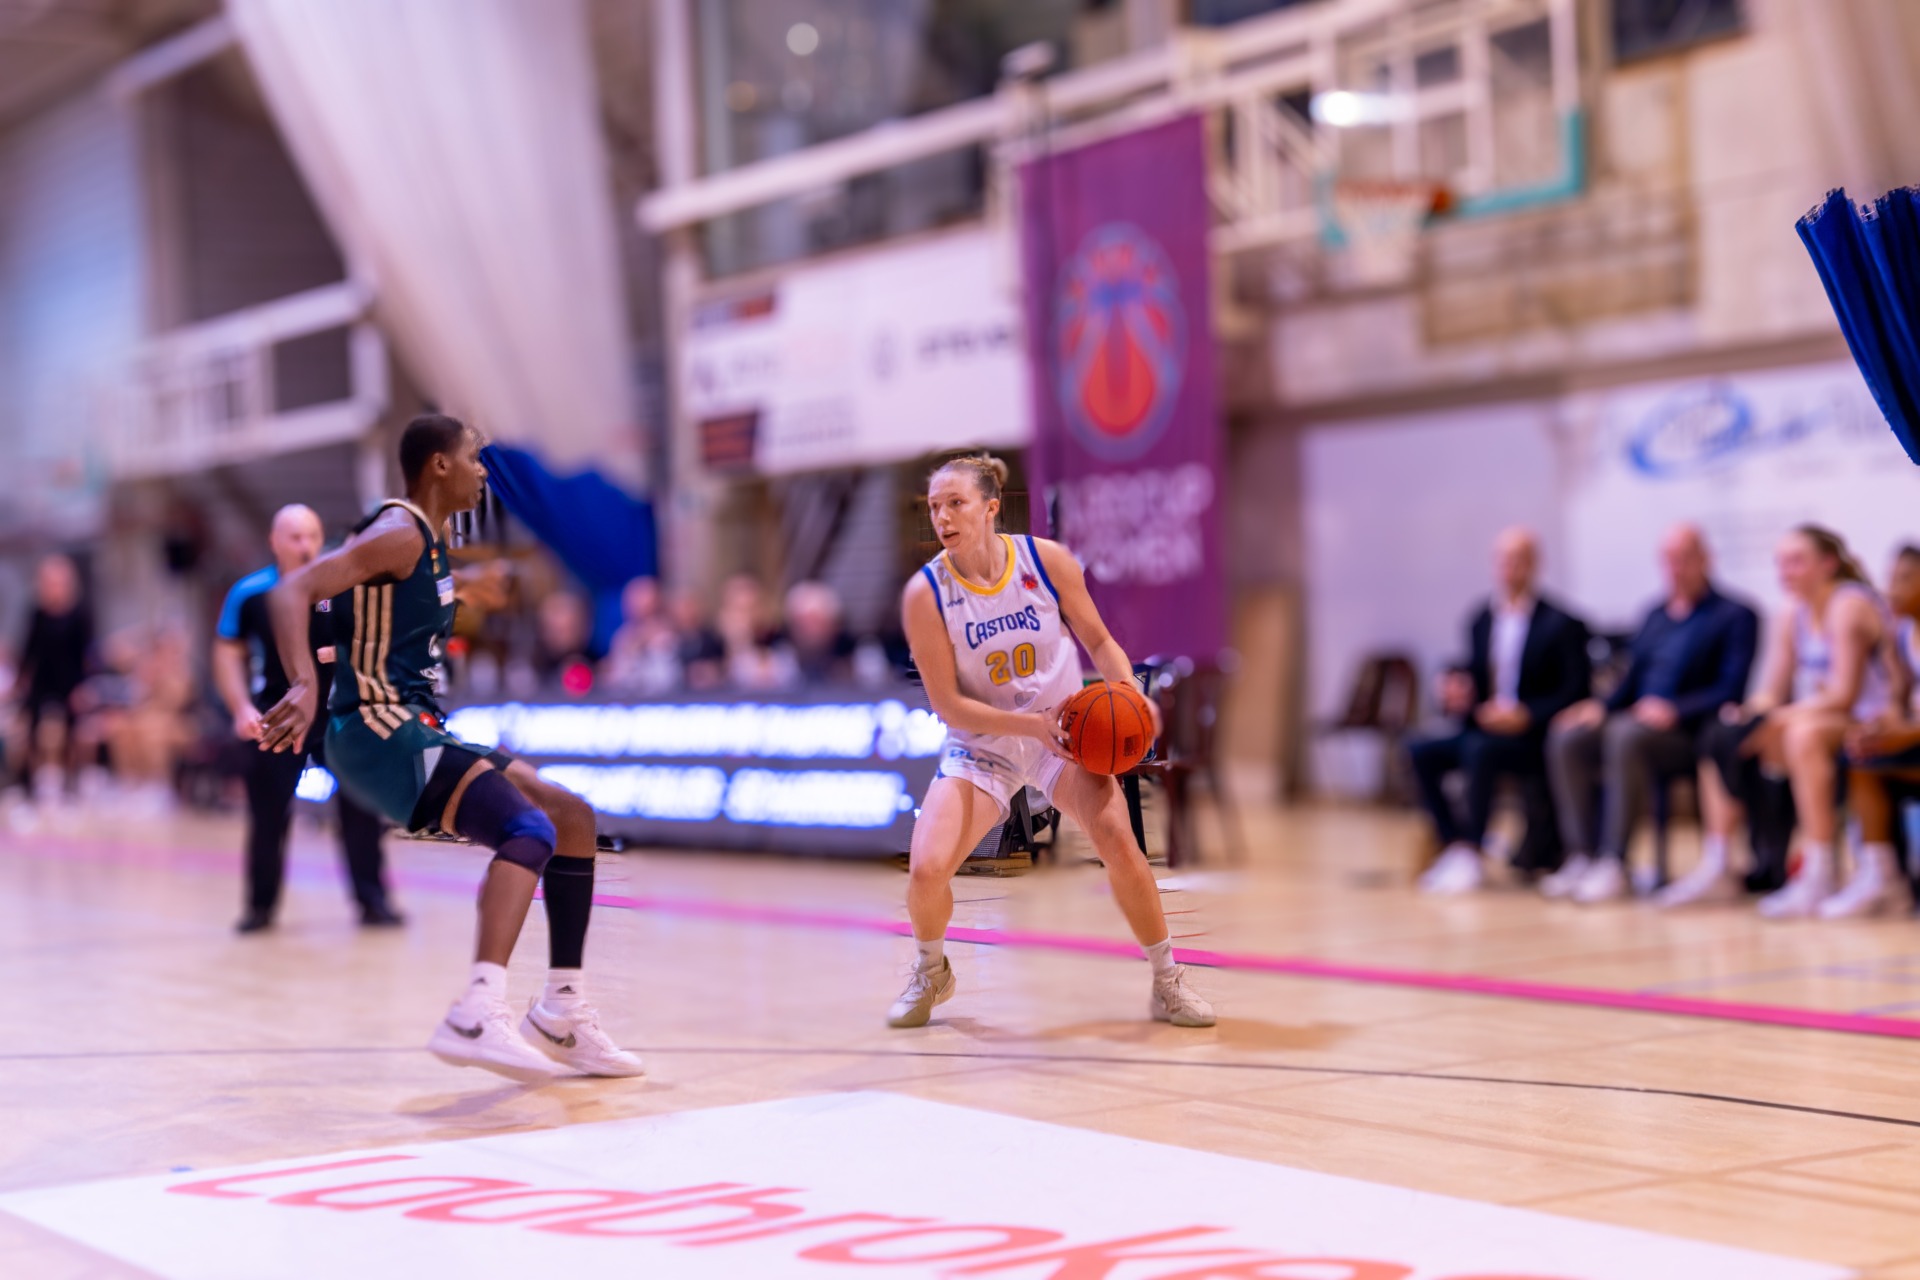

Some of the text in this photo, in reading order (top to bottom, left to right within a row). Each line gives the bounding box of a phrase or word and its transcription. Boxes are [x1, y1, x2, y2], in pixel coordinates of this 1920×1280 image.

[965, 604, 1041, 650] CASTORS
[985, 641, 1036, 687] 20
[166, 1154, 1576, 1280] Ladbroke
